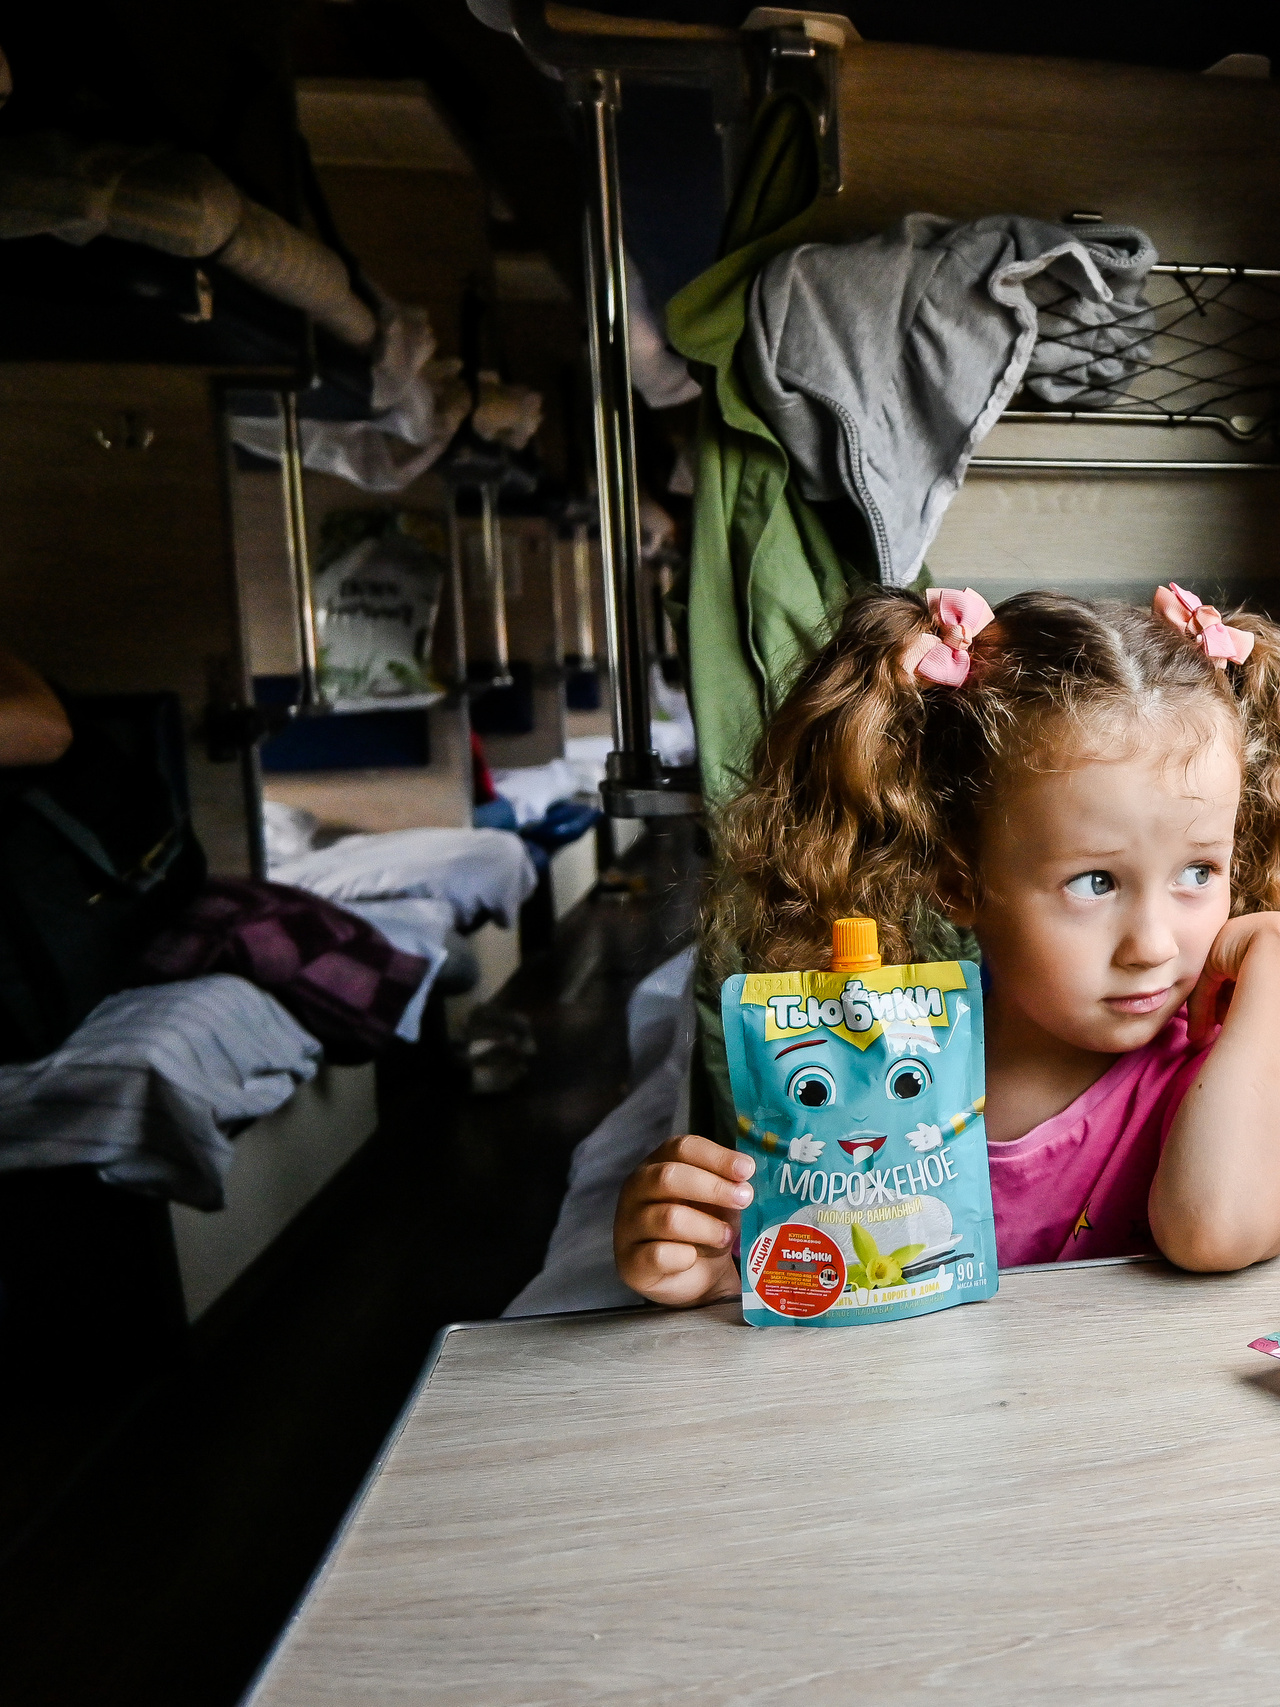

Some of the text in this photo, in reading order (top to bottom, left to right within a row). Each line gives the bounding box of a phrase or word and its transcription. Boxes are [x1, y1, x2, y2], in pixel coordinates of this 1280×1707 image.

[779, 1147, 959, 1206] МОРОЖЕНОЕ
[817, 1197, 923, 1225] ПЛОМБИР ВАНИЛЬНЫЙ
[751, 1236, 773, 1275] АКЦИЯ
[957, 1261, 974, 1282] 90
[881, 1290, 908, 1304] ДОРОГЕ
[919, 1282, 940, 1295] ДОМА
